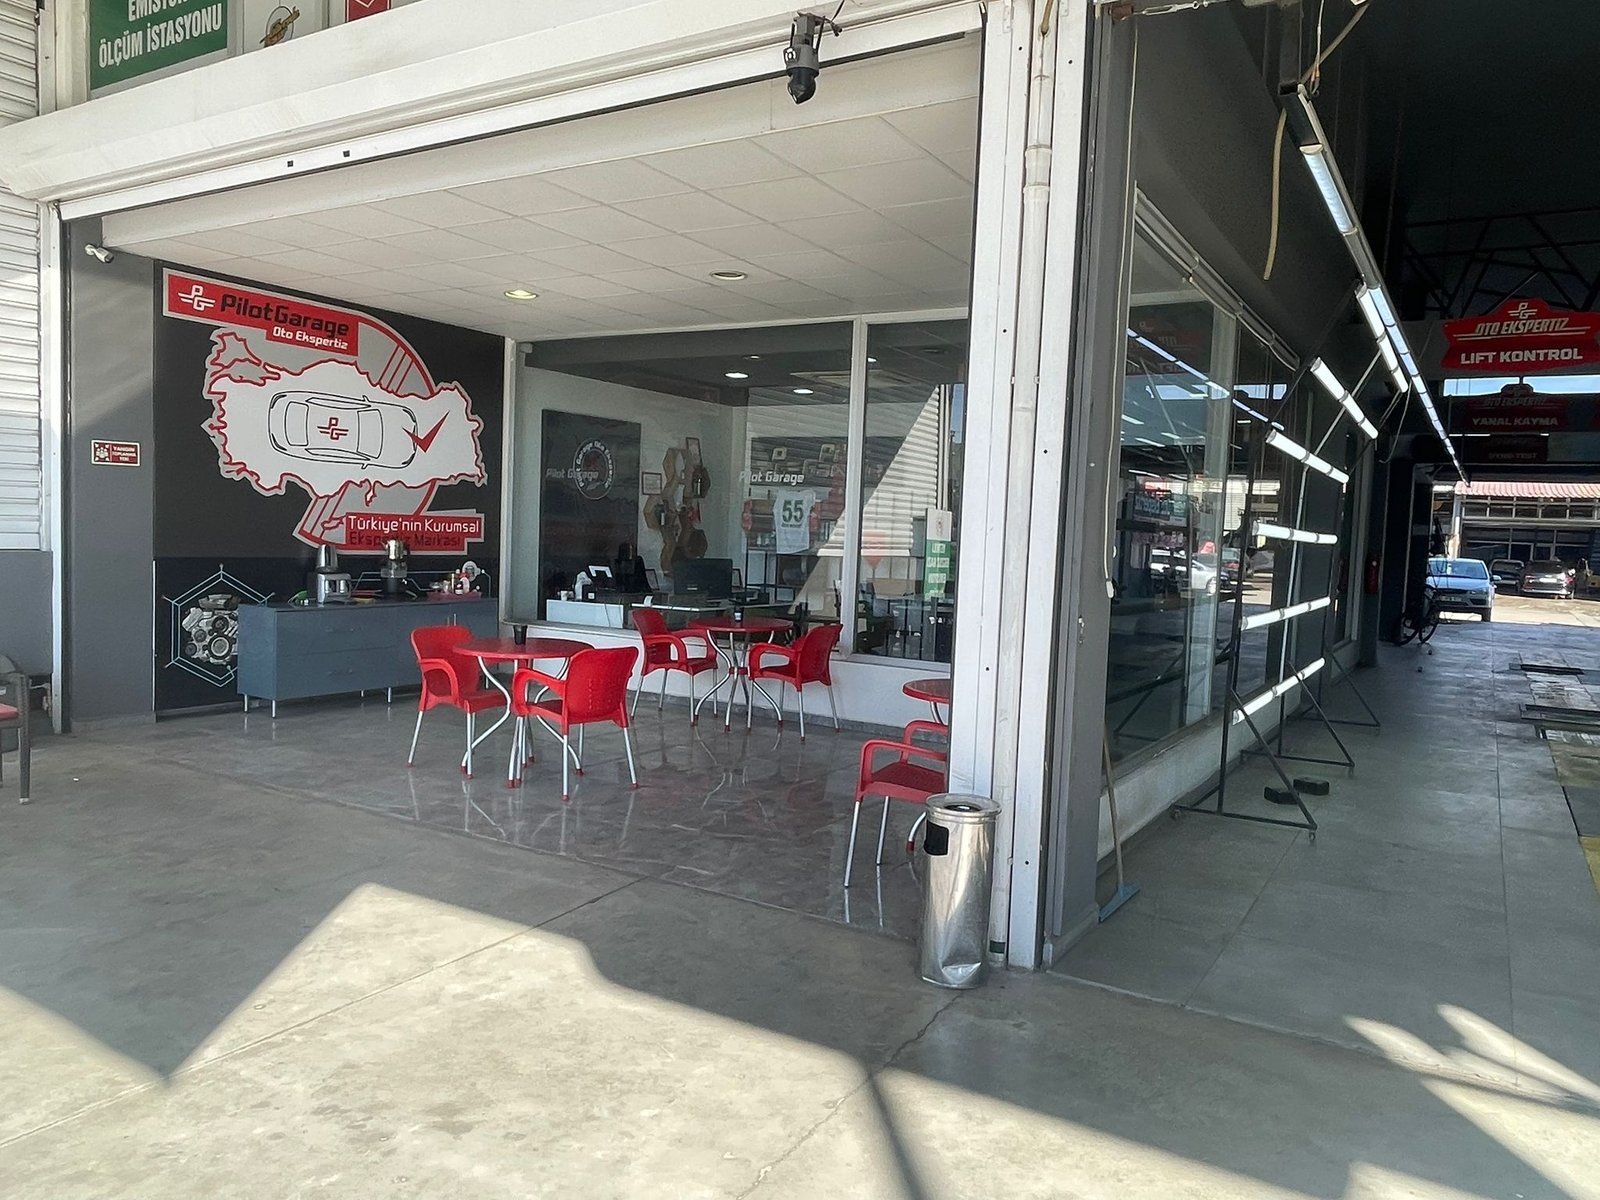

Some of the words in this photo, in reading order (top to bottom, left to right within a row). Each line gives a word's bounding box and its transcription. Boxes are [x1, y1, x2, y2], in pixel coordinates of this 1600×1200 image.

[99, 30, 143, 68] ÖLÇÜM
[146, 3, 222, 53] İSTASYONU
[272, 325, 294, 341] Oto
[295, 330, 349, 351] Ekspertiz
[1475, 322, 1500, 337] OTO
[1460, 351, 1497, 364] LIFT
[1500, 347, 1583, 363] KONTROL
[1472, 416, 1512, 426] YANAL
[1513, 416, 1558, 426] KAYMA
[765, 471, 805, 486] Garage
[782, 499, 805, 523] 55
[348, 515, 422, 534] Türkiye'nin
[424, 519, 480, 533] Kurumsal
